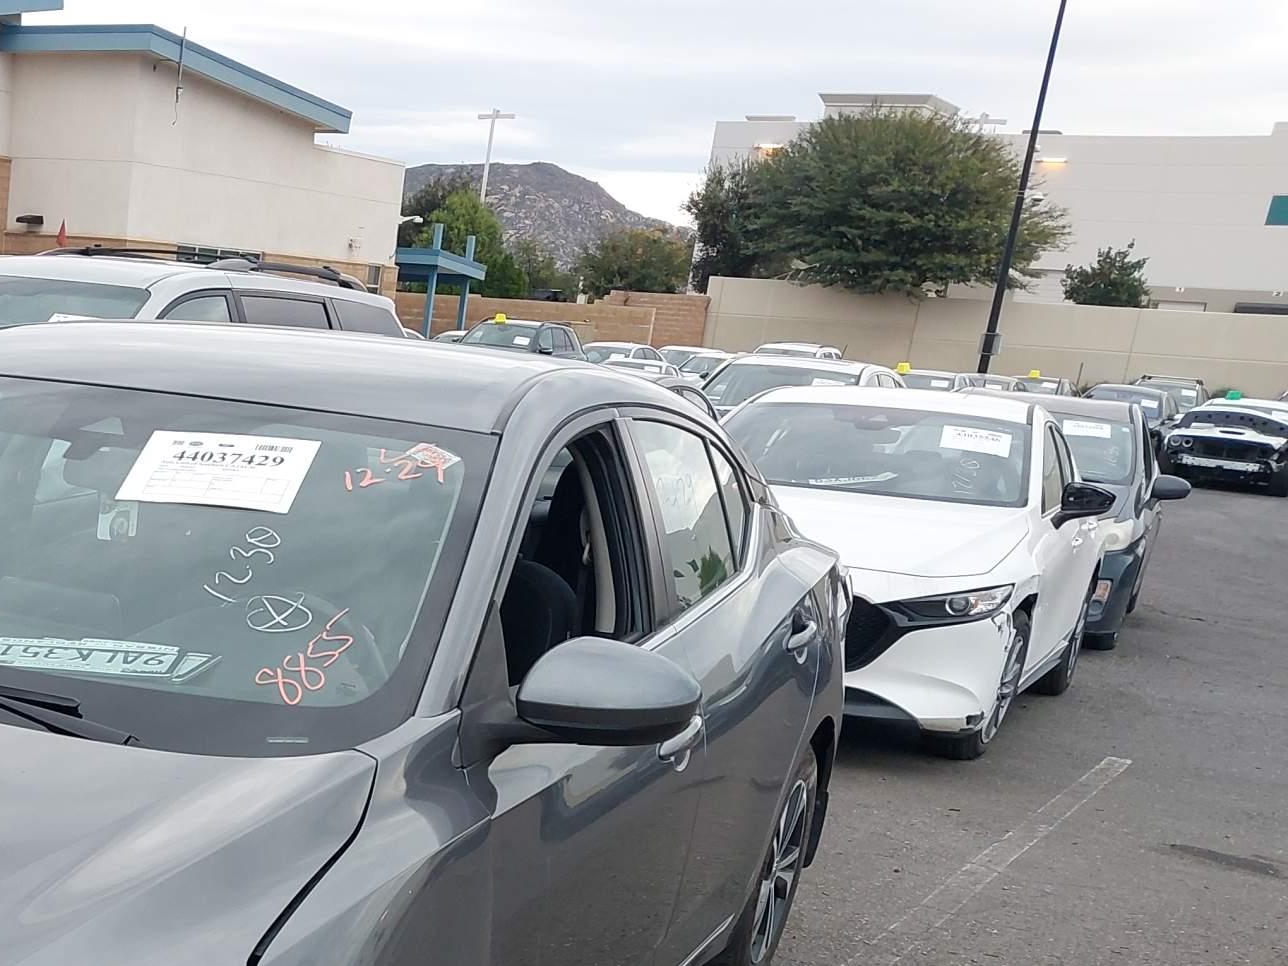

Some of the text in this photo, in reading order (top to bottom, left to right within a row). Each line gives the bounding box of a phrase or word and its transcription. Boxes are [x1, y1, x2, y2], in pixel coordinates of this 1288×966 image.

[172, 449, 285, 468] 44037429
[0, 644, 165, 667] 9ALK351
[255, 607, 354, 705] 8855
